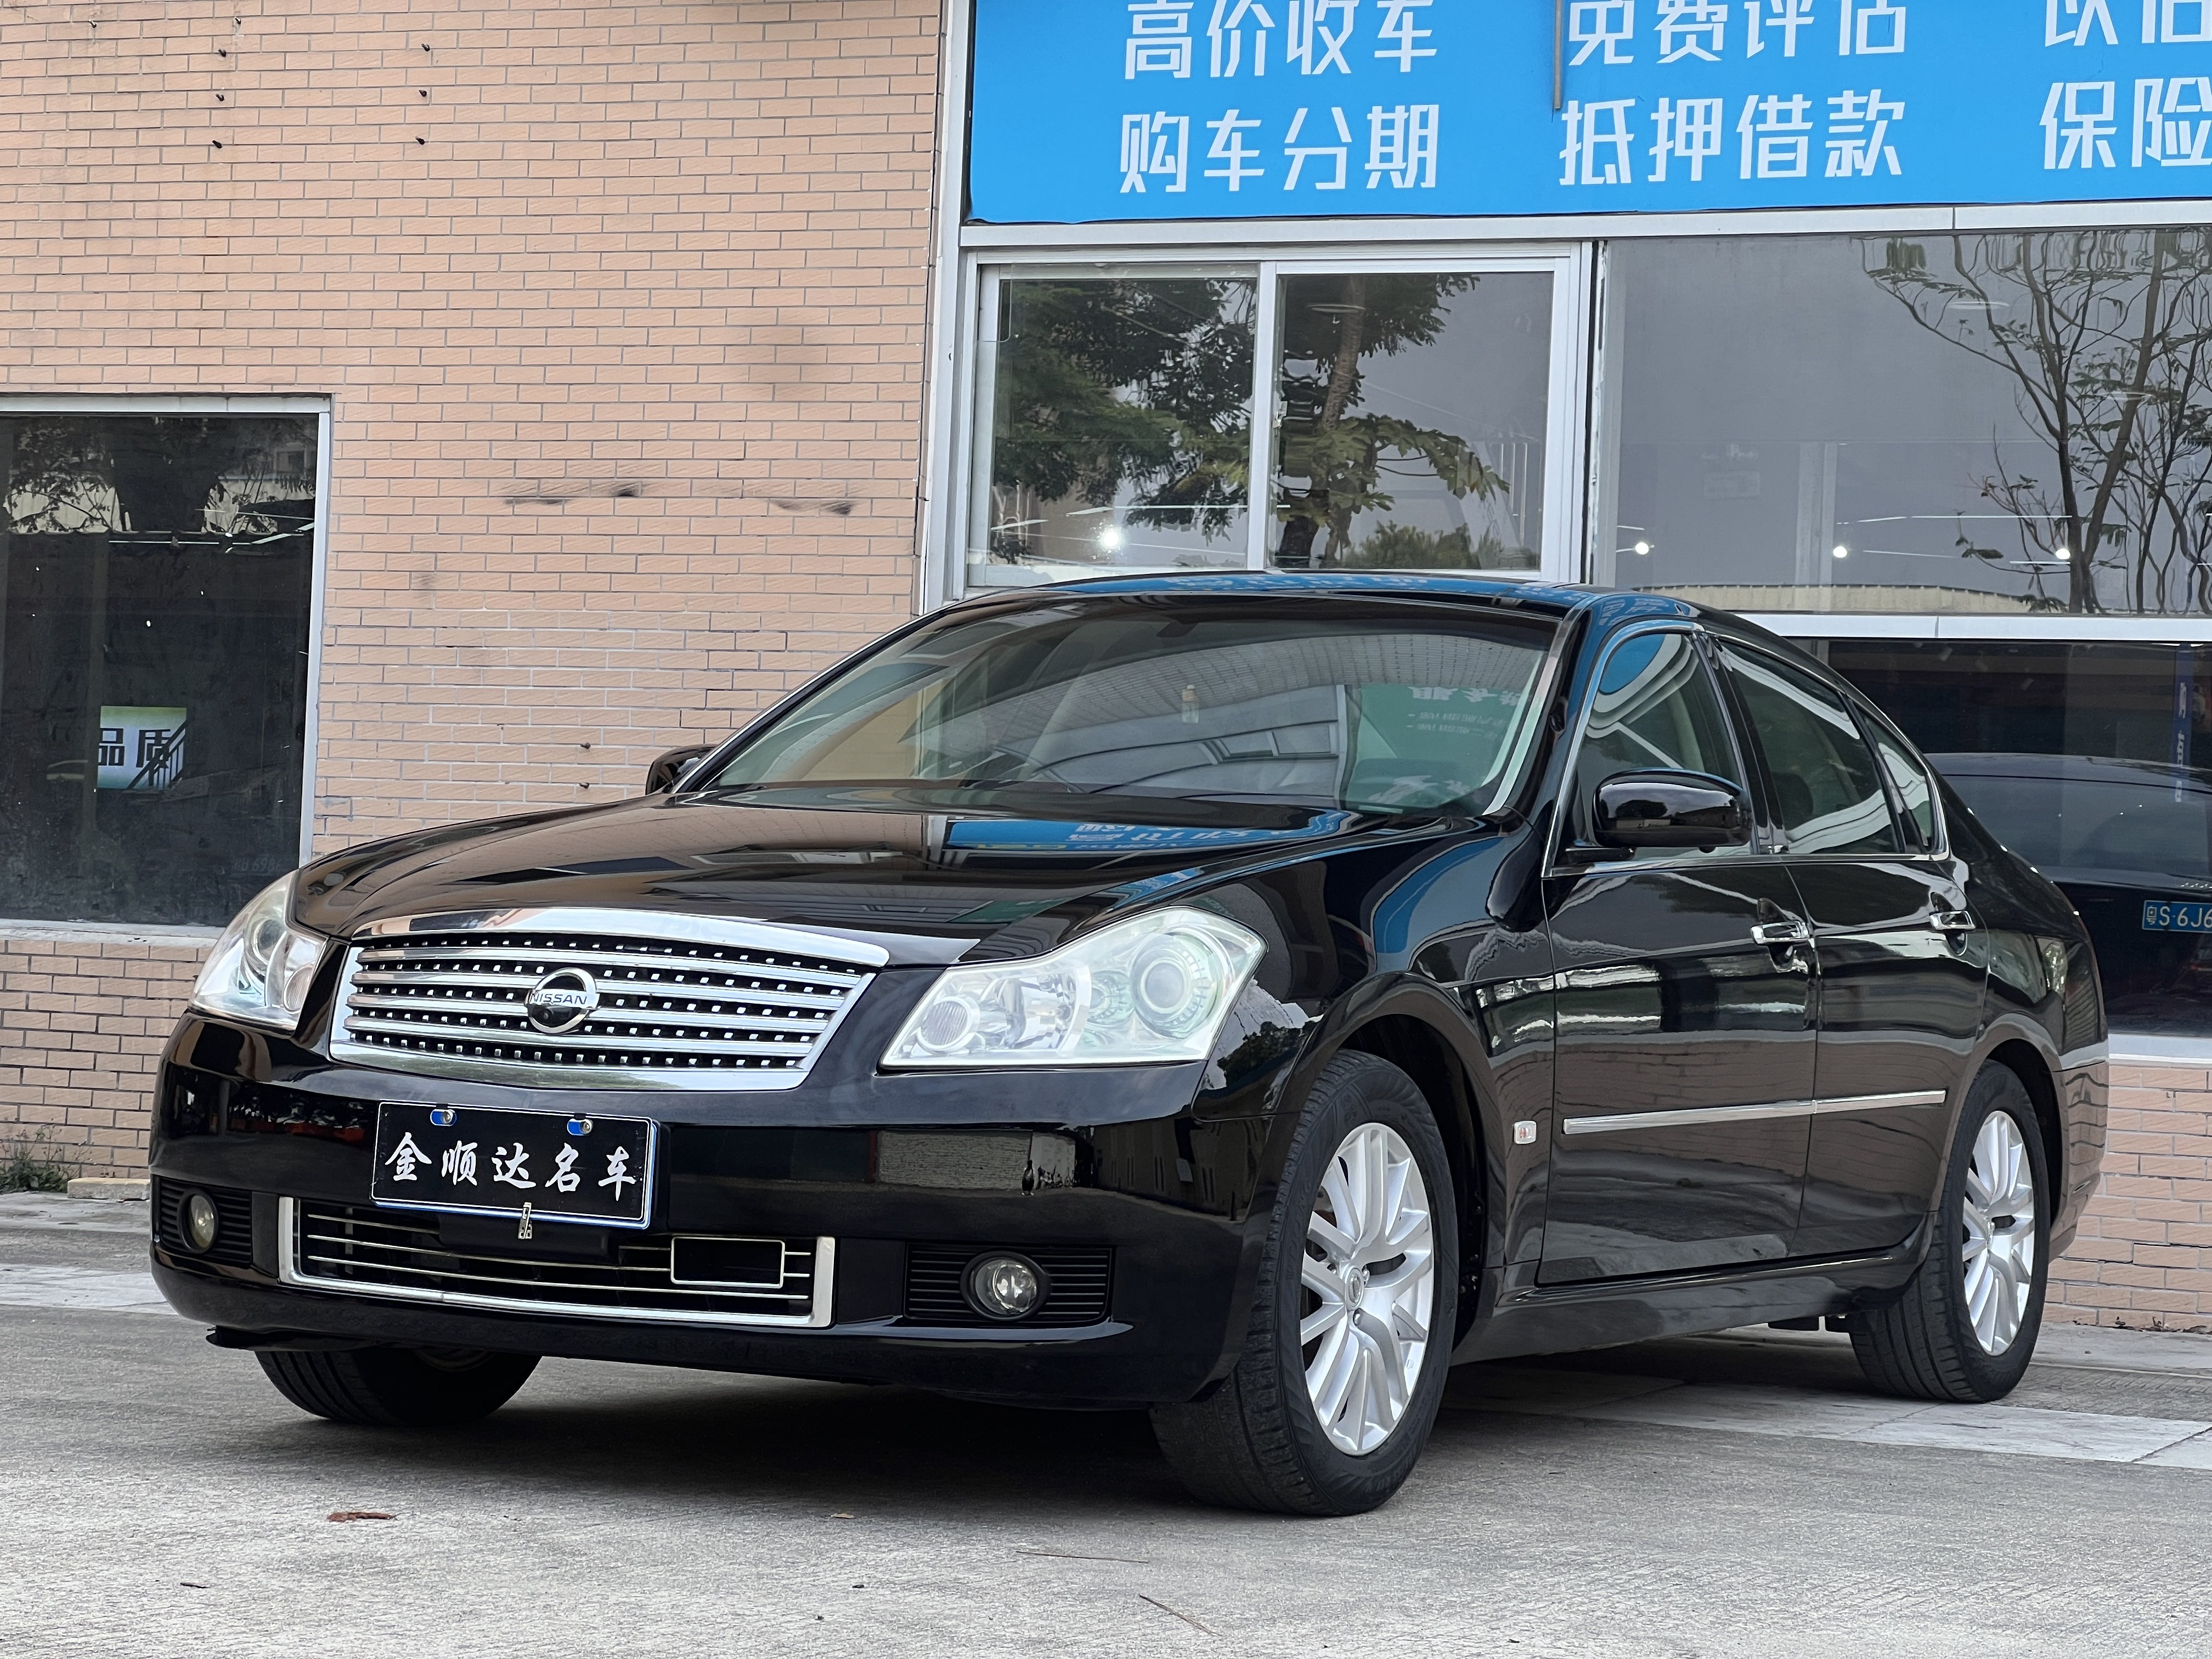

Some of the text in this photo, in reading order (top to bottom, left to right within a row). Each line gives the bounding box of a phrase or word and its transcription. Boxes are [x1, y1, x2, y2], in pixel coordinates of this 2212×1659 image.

[1126, 0, 1437, 80] 高价收车
[1568, 0, 1906, 66] 免费评估
[1120, 104, 1439, 193] 购车分期
[1559, 89, 1906, 185] 抵押借款
[2039, 77, 2212, 169] 保险
[529, 993, 588, 1005] NISSAN
[385, 1132, 636, 1201] 金顺达名车
